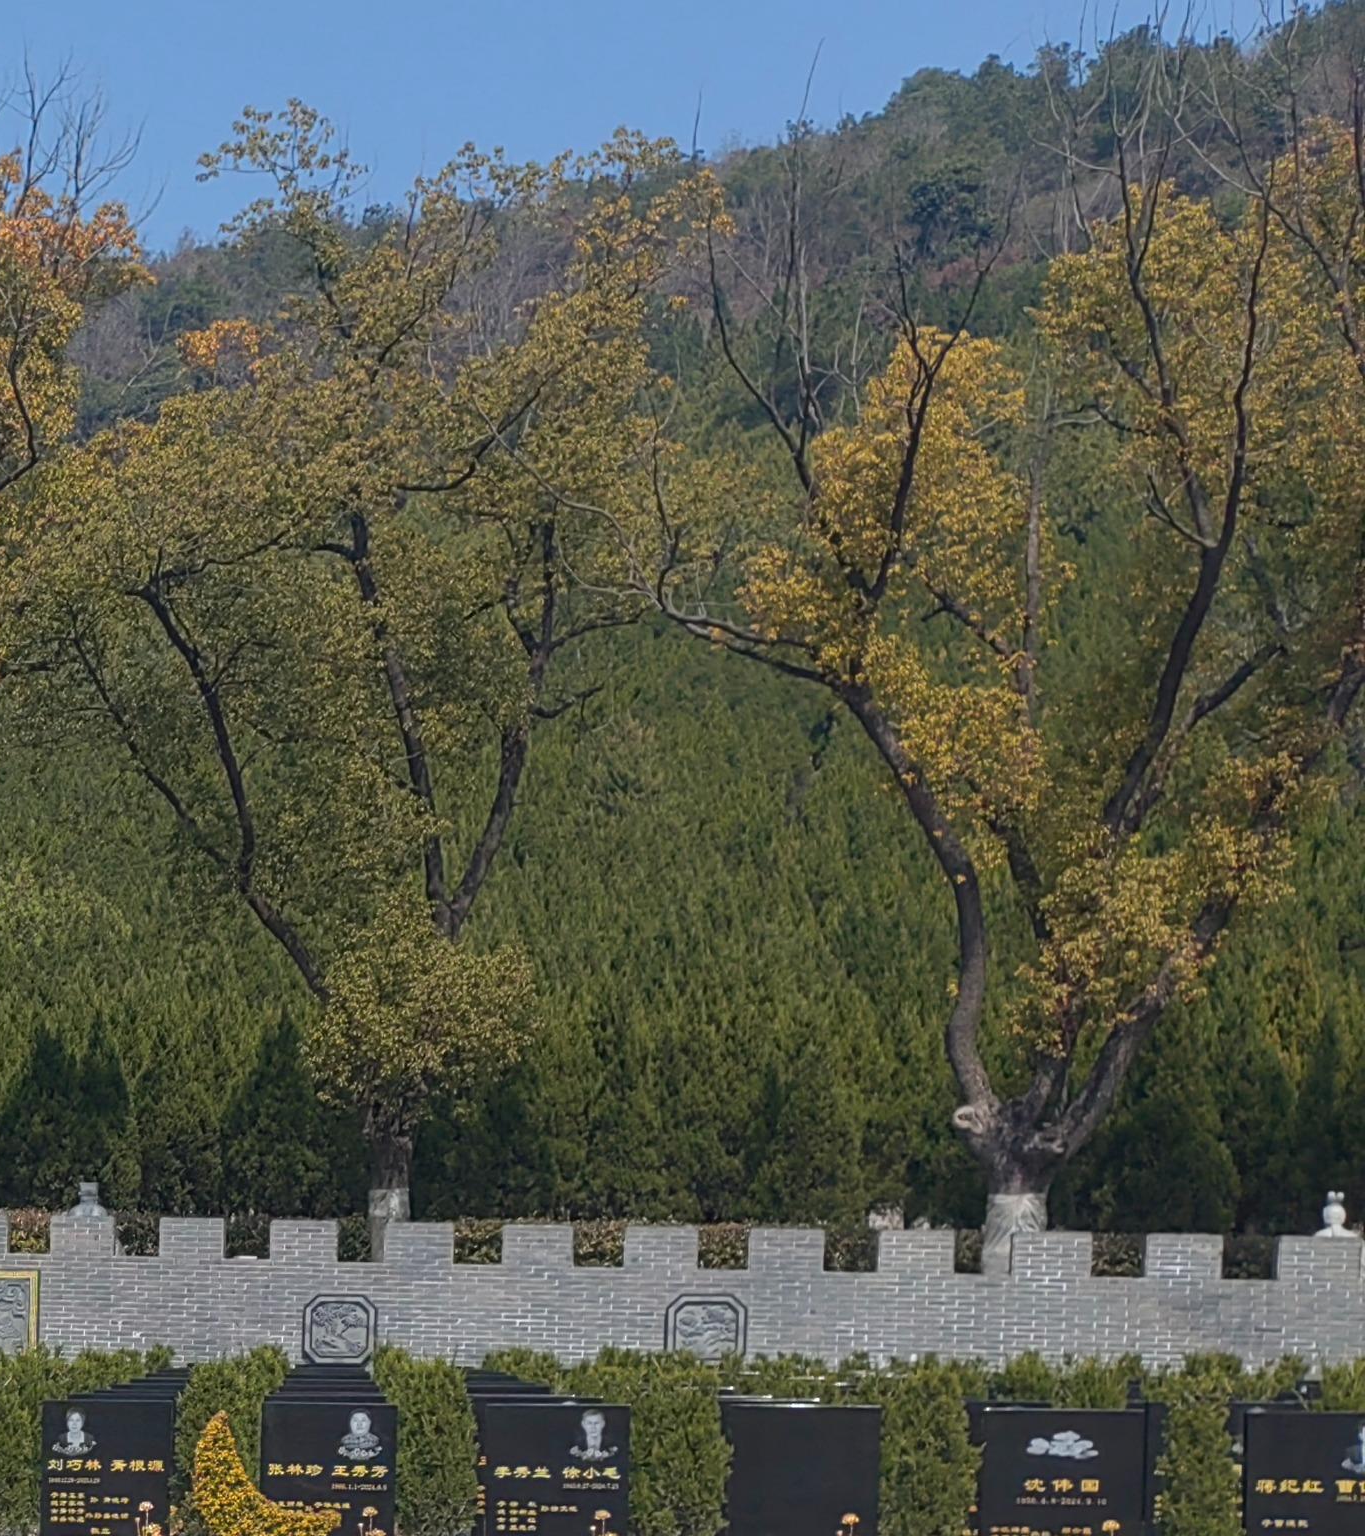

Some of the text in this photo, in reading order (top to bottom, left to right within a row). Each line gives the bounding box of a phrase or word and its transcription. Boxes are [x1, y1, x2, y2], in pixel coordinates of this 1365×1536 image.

[47, 1459, 103, 1471] 刘巧林
[267, 1463, 389, 1477] 张林珍 王秀芳
[562, 1466, 622, 1480] 徐小毛
[1024, 1478, 1101, 1493] 沈伟国
